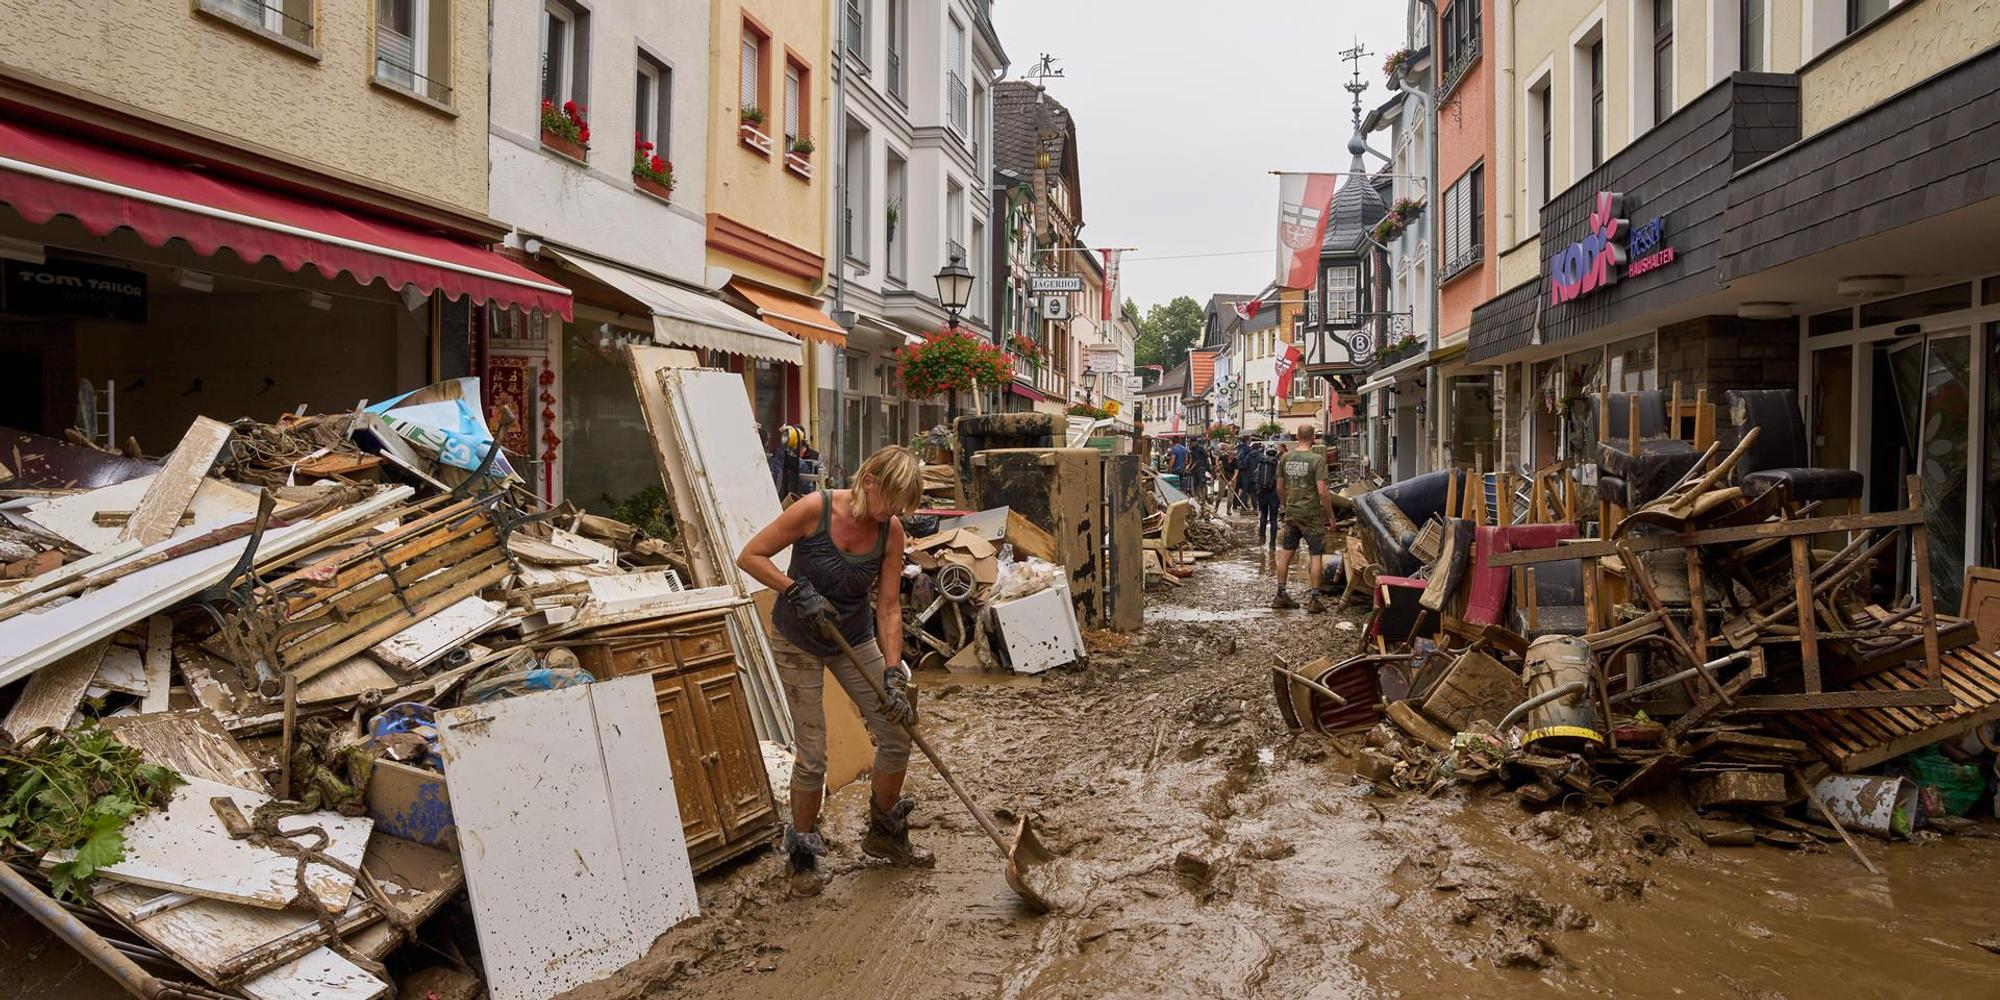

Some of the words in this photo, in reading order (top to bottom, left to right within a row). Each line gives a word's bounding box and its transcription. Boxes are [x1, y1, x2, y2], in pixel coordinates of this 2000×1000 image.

[1629, 247, 1676, 278] HAUSHALTEN
[18, 271, 83, 287] TOM
[86, 279, 143, 297] TAILOR
